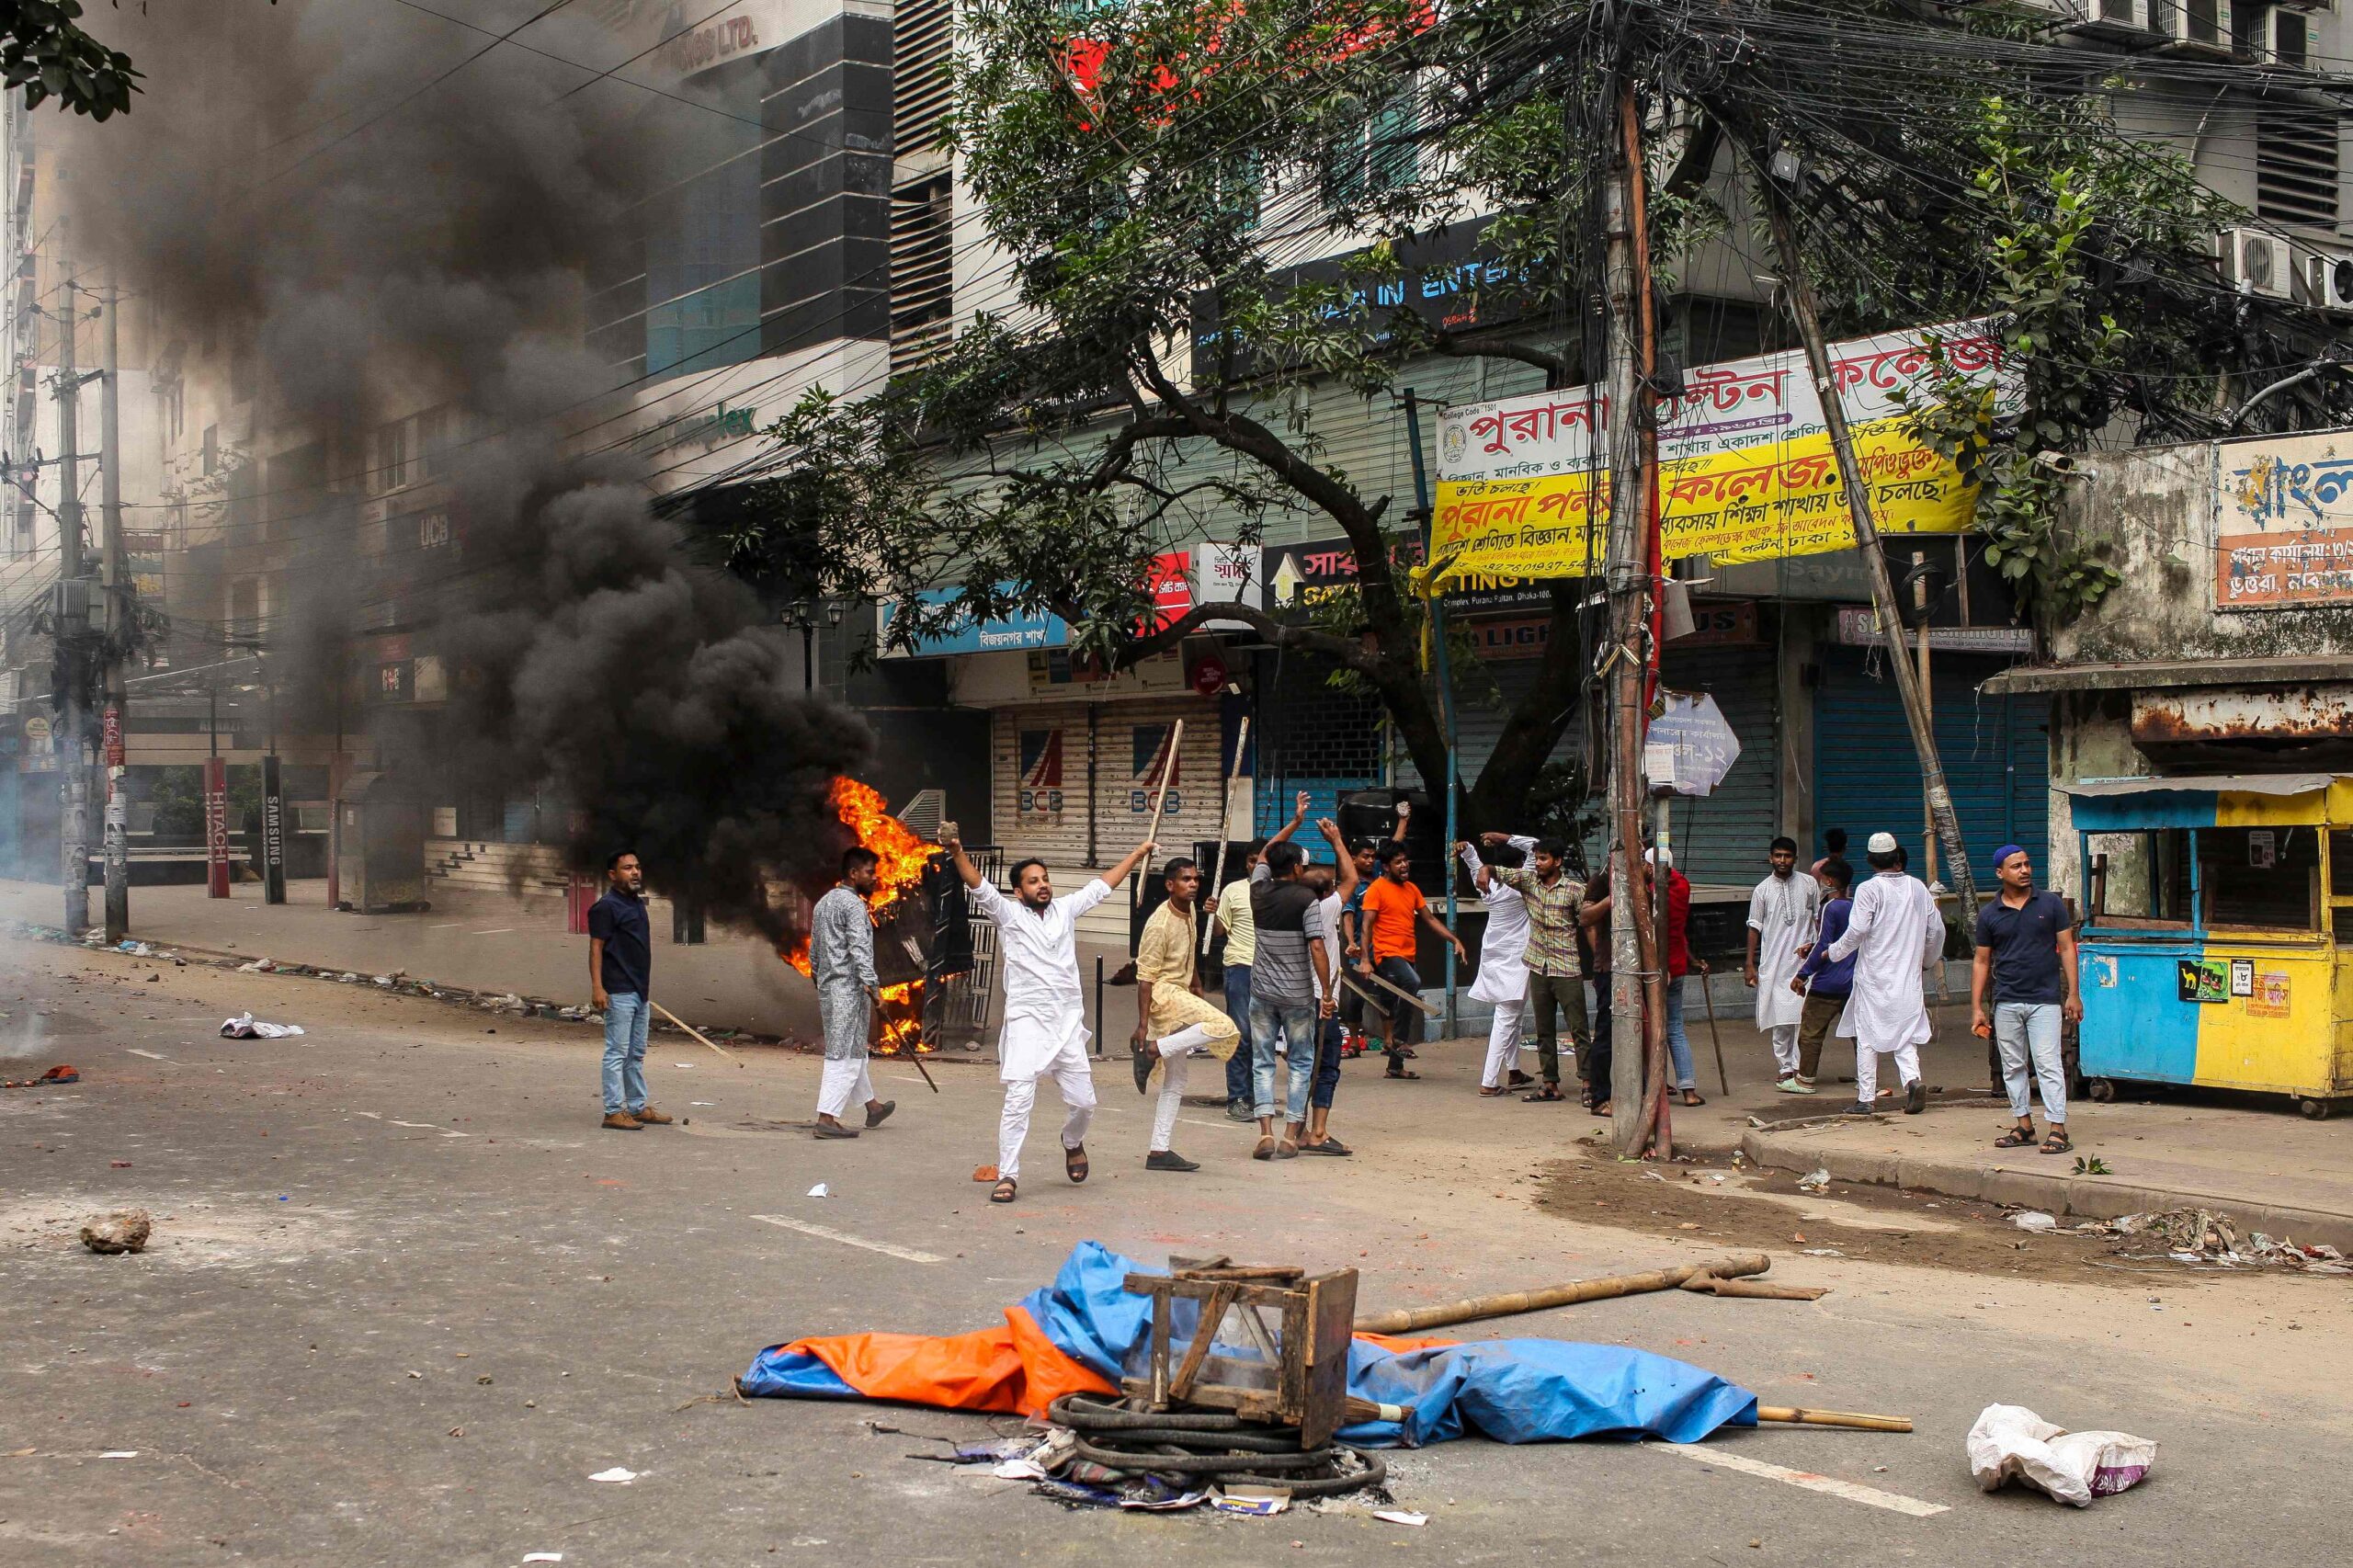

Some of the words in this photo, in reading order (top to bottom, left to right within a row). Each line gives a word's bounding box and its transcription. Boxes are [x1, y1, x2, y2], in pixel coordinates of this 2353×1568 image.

[1443, 408, 1464, 420] College
[1465, 407, 1480, 416] Code
[1484, 403, 1497, 413] 1501
[1495, 460, 1545, 480] মানবিক
[1550, 459, 1561, 472] ও
[1718, 431, 1775, 450] একাদশ
[1441, 494, 1536, 543] পুরানা
[1665, 452, 1836, 506] কলেজ
[420, 514, 449, 550] UCB
[1472, 528, 1517, 552] শ্রেণিতে
[1519, 524, 1573, 549] বিজ্ঞান,
[1660, 511, 1720, 537] ব্যবসায়
[1722, 501, 1769, 529] শিক্ষা
[1772, 491, 1829, 517] শাখায়
[1746, 524, 1771, 541] থেকে
[1791, 515, 1837, 533] আবেদন
[979, 630, 1023, 648] বিজয়নগর
[1025, 628, 1048, 643] শাখা
[1020, 790, 1063, 812] BCB
[1131, 790, 1181, 814] BCB
[212, 791, 227, 865] HITACHI
[267, 796, 281, 866] SAMSUNG
